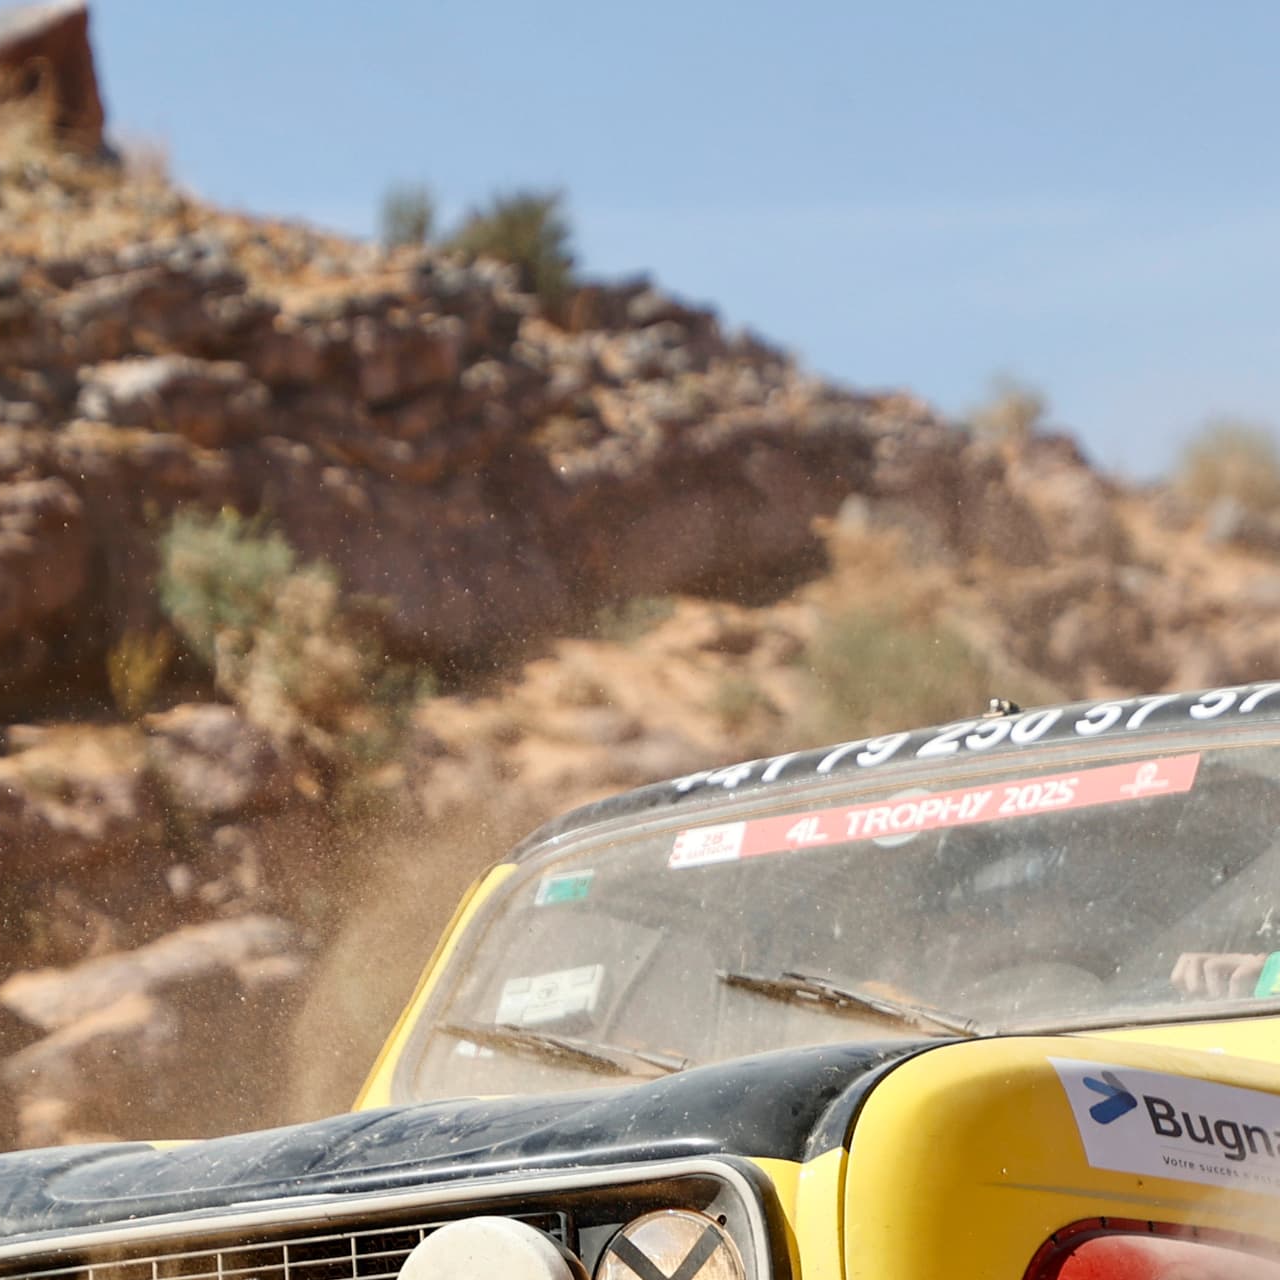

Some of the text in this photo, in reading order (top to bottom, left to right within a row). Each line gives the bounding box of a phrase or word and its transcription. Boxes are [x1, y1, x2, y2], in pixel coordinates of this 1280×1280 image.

[816, 731, 911, 774] 79
[916, 708, 1064, 757] 250
[1075, 693, 1181, 735] 57
[786, 778, 1079, 844] 4L TROPHY 2025
